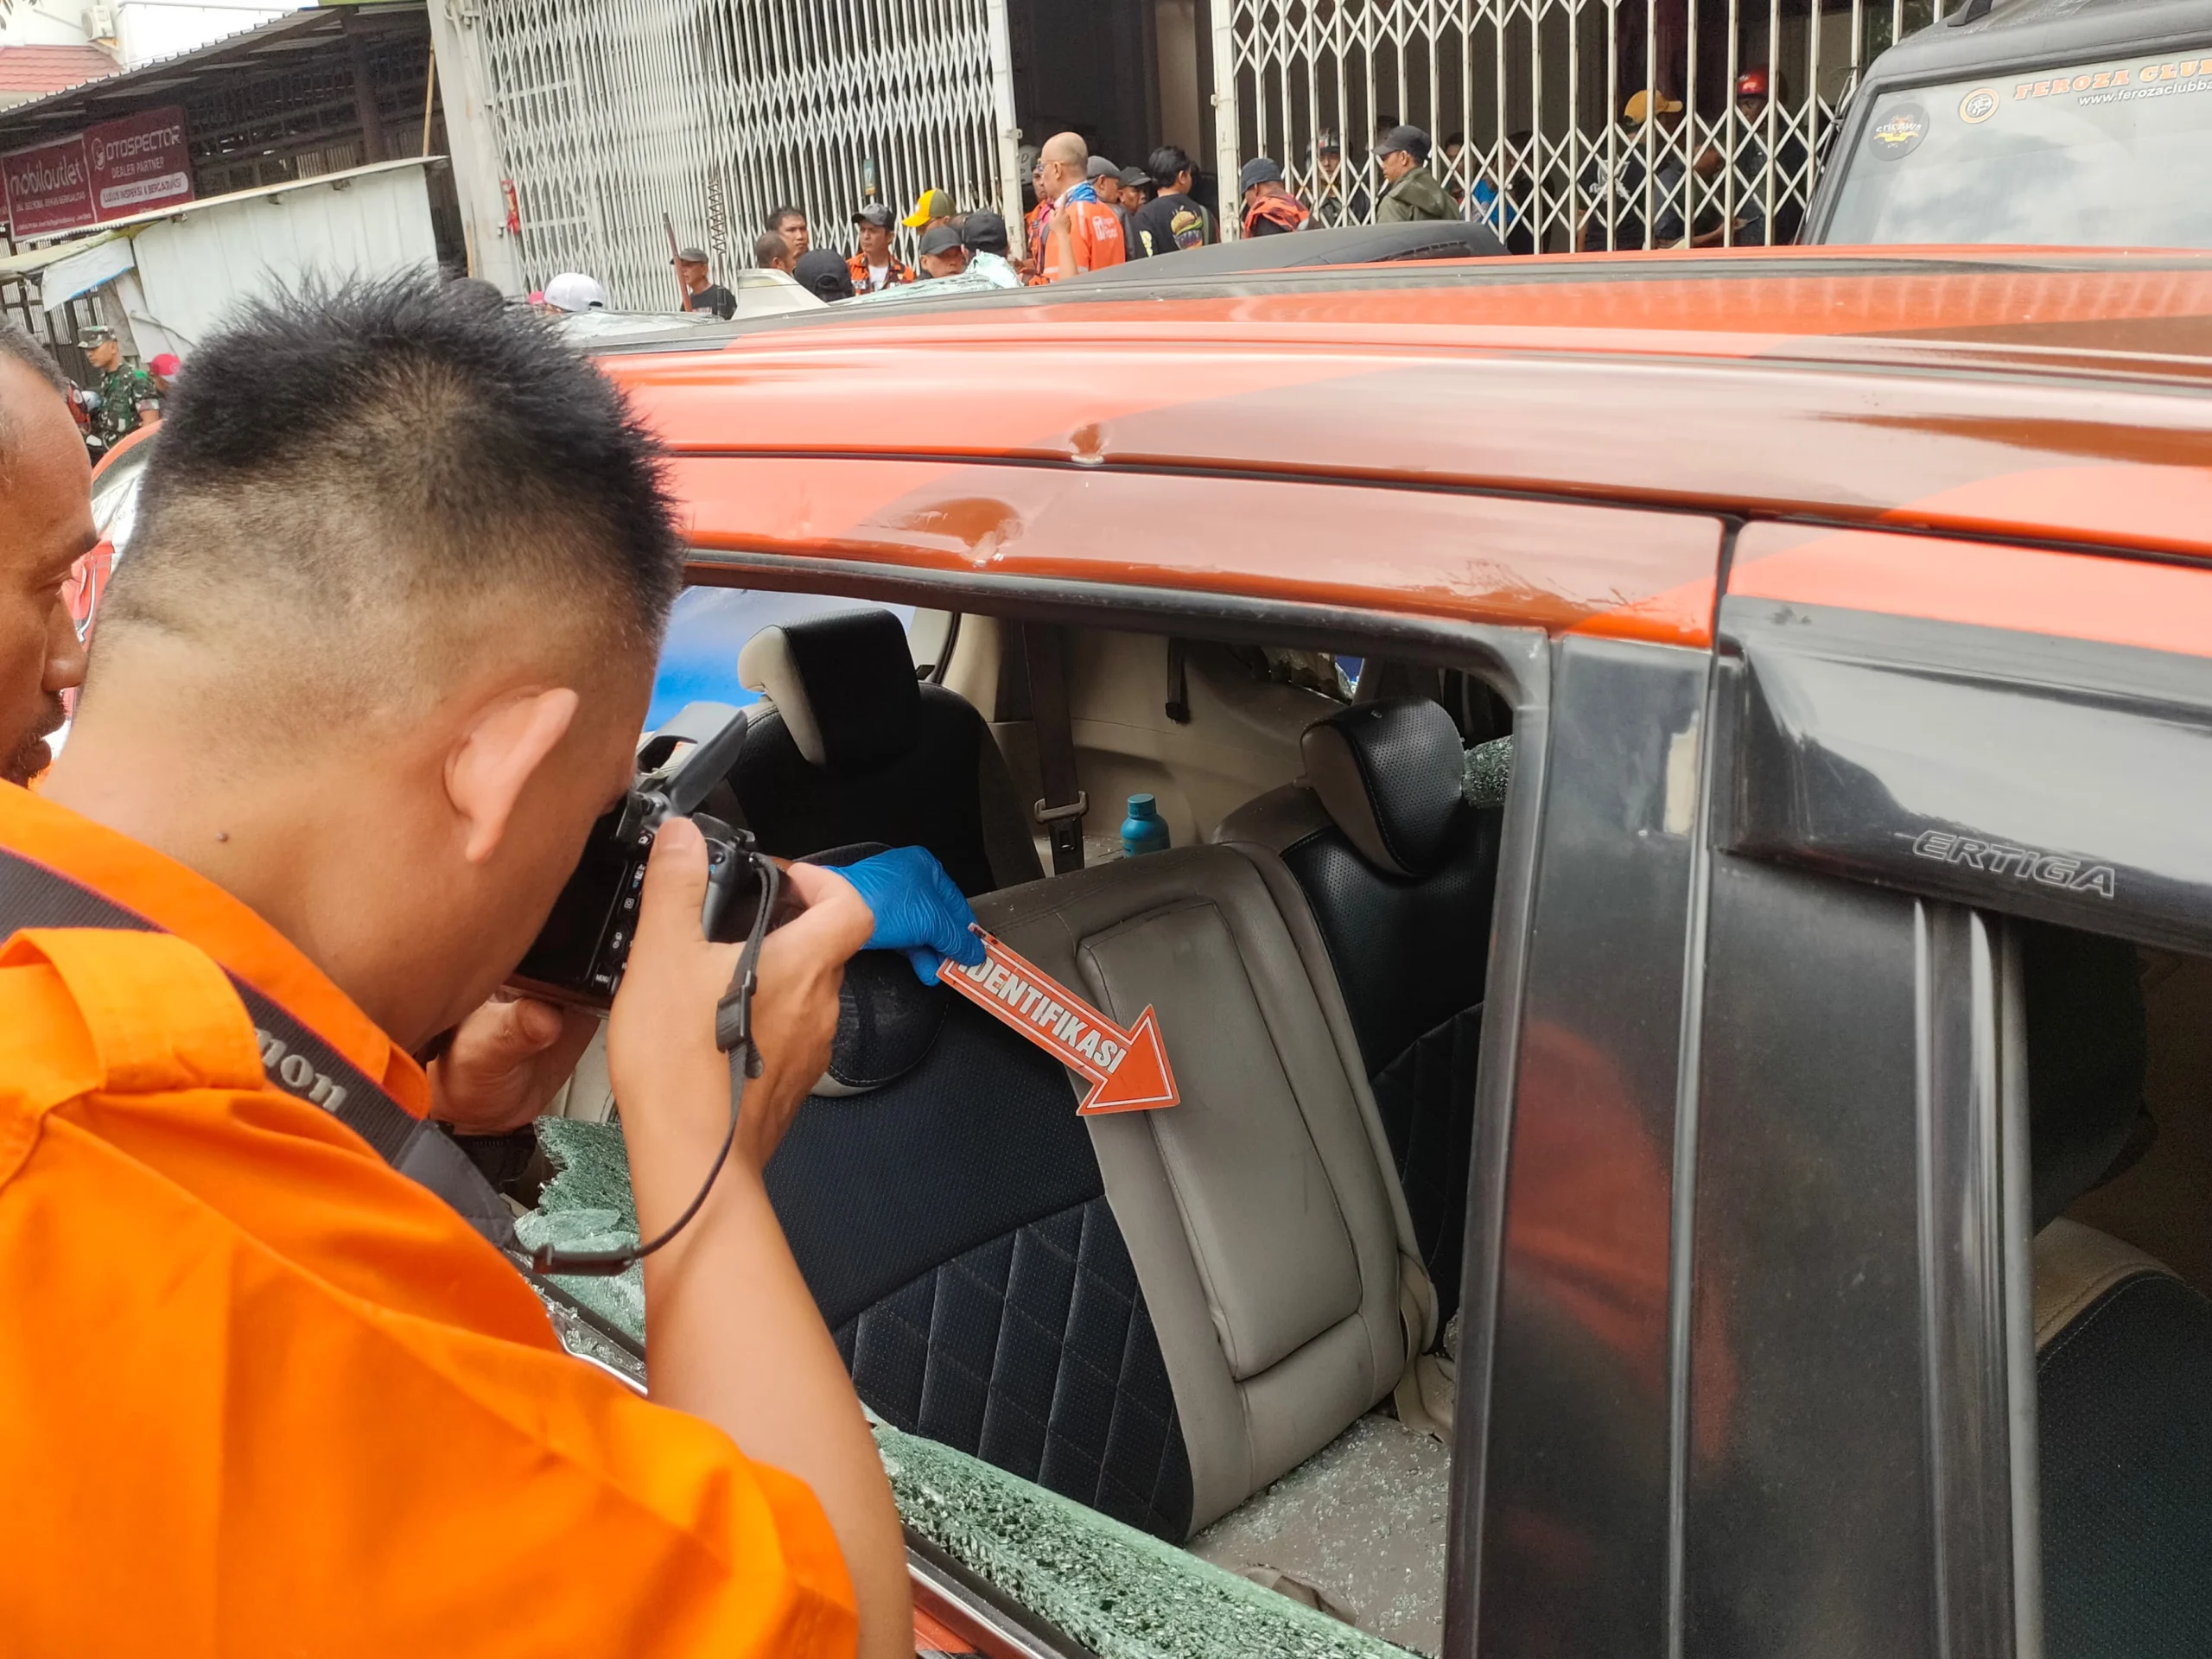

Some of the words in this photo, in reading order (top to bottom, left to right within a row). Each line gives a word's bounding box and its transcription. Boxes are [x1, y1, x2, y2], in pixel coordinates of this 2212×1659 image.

[2014, 70, 2130, 100] FEROZA
[106, 125, 181, 161] OTOSPECTOR
[1912, 830, 2114, 899] ERTIGA
